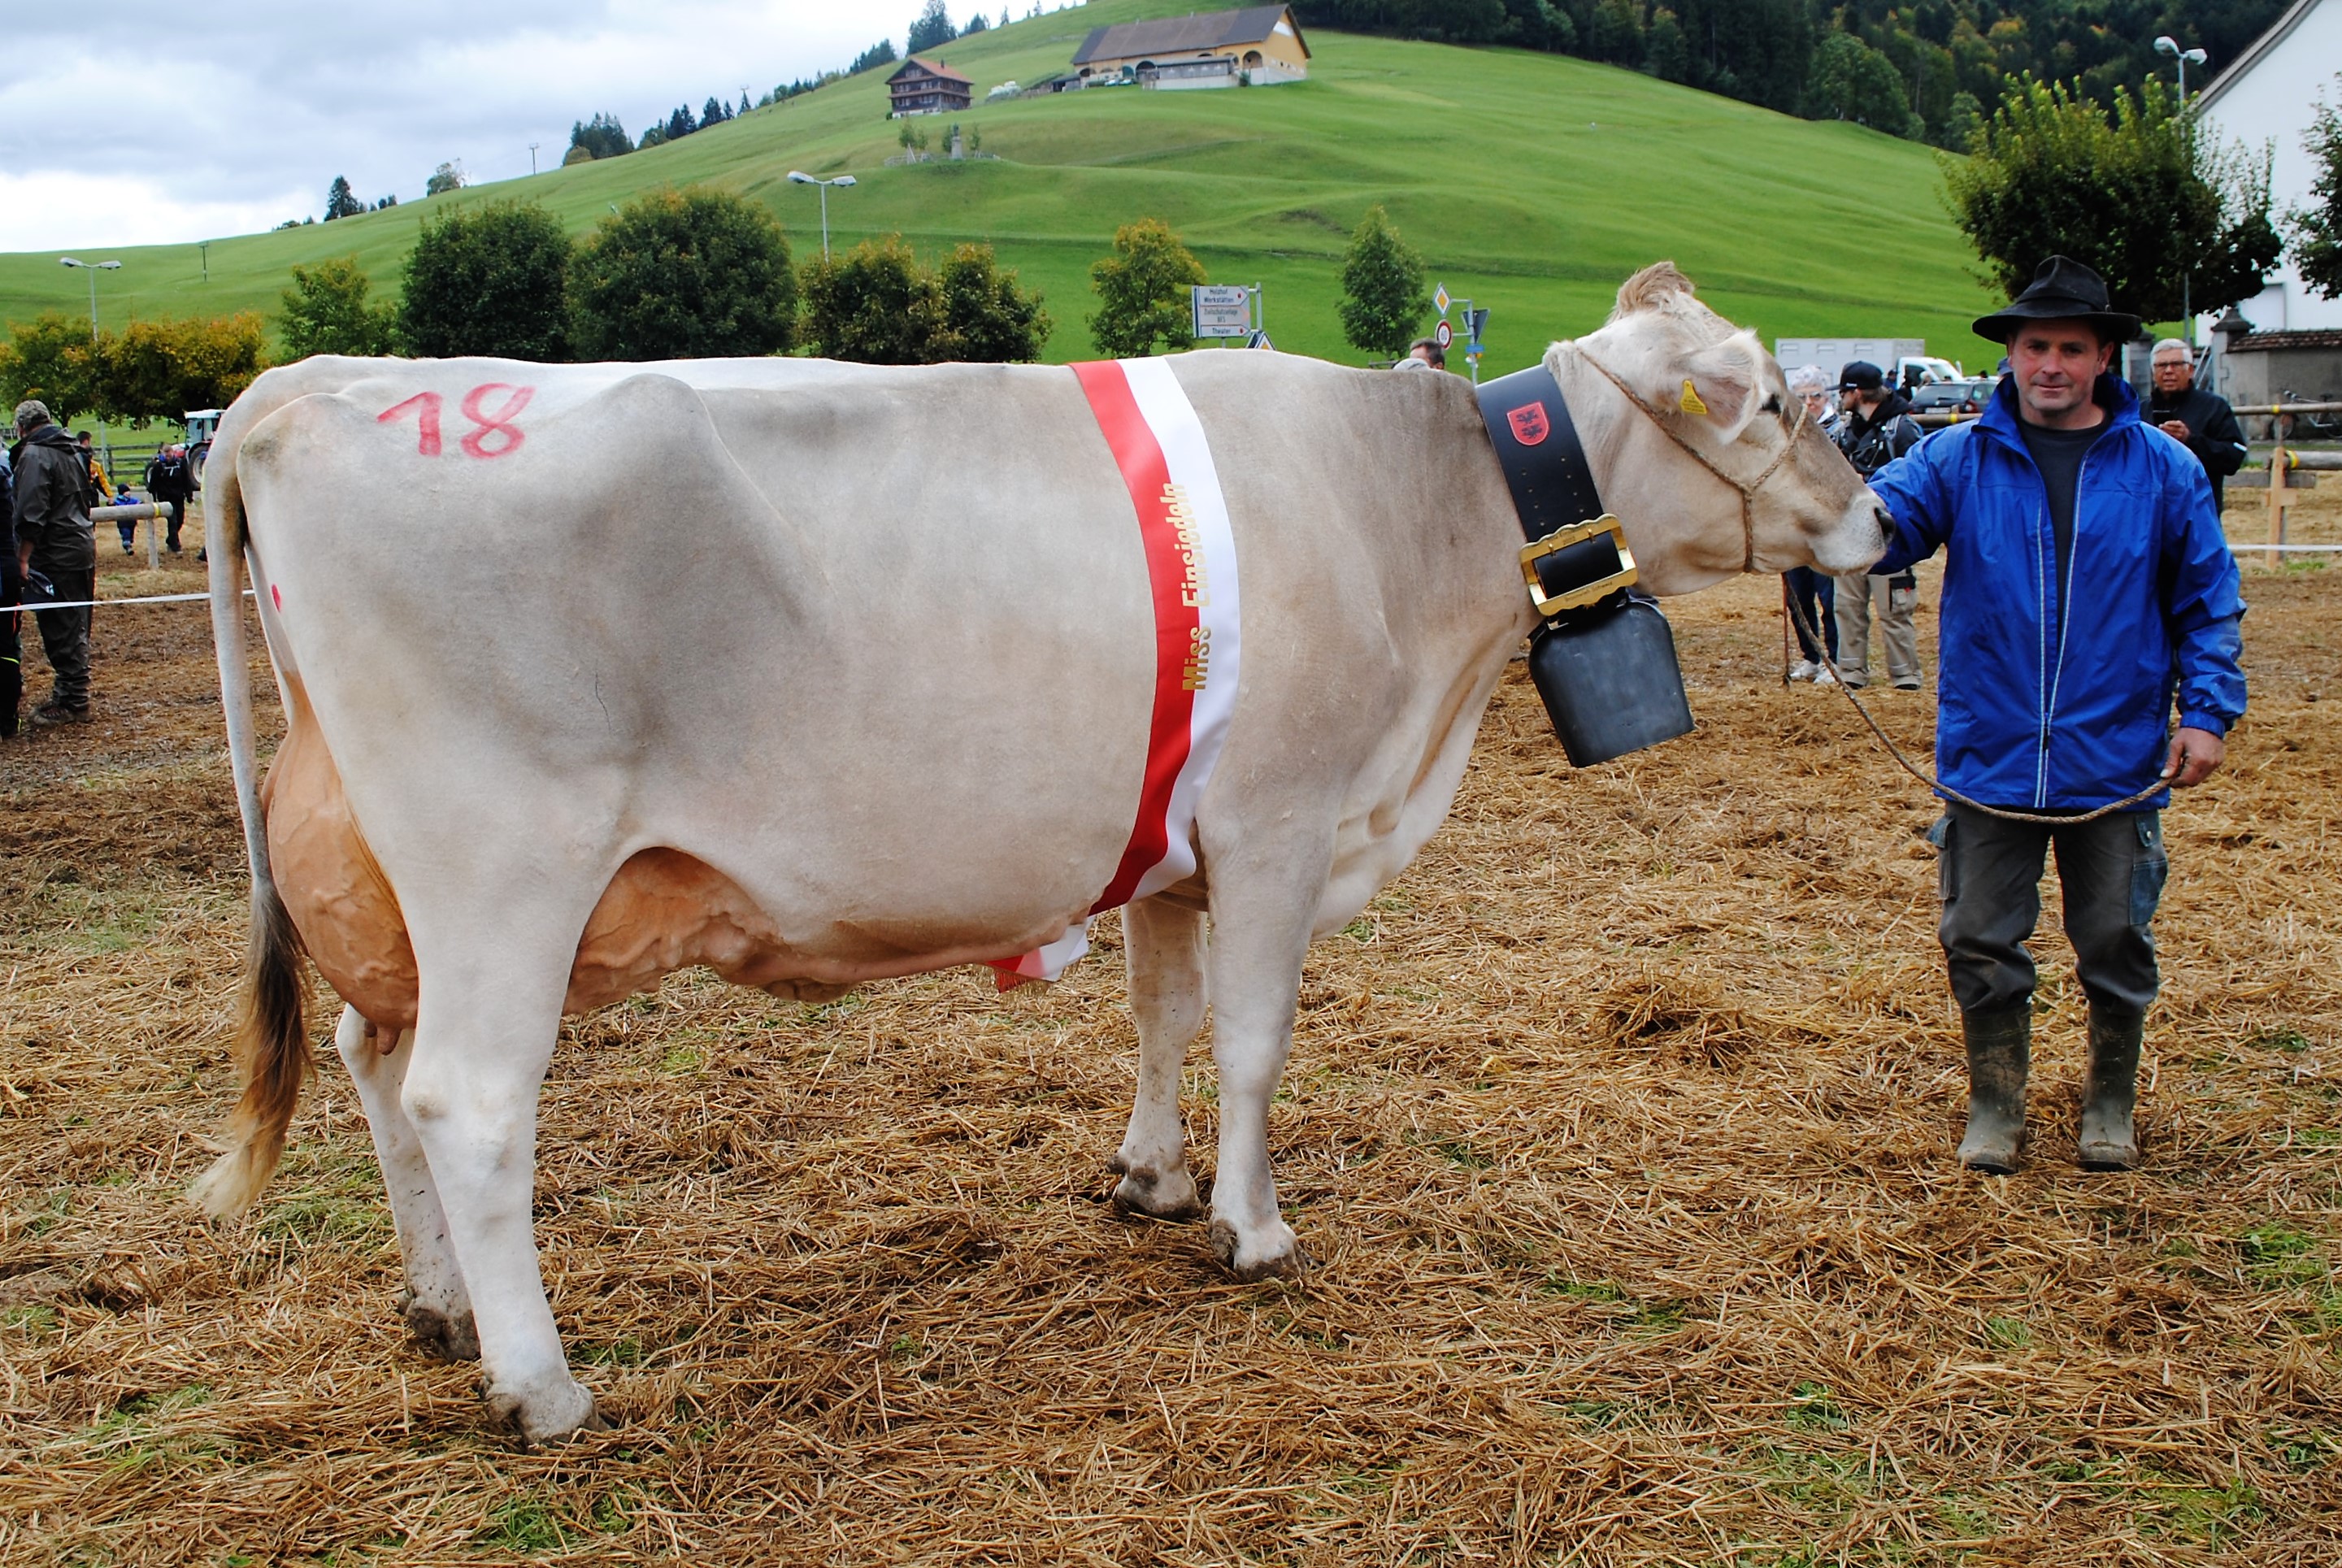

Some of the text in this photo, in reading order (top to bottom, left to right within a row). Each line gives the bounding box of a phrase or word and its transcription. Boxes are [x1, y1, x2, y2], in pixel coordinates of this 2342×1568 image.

[376, 382, 537, 460] 18
[1159, 483, 1212, 690] Miss Einsiedeln
